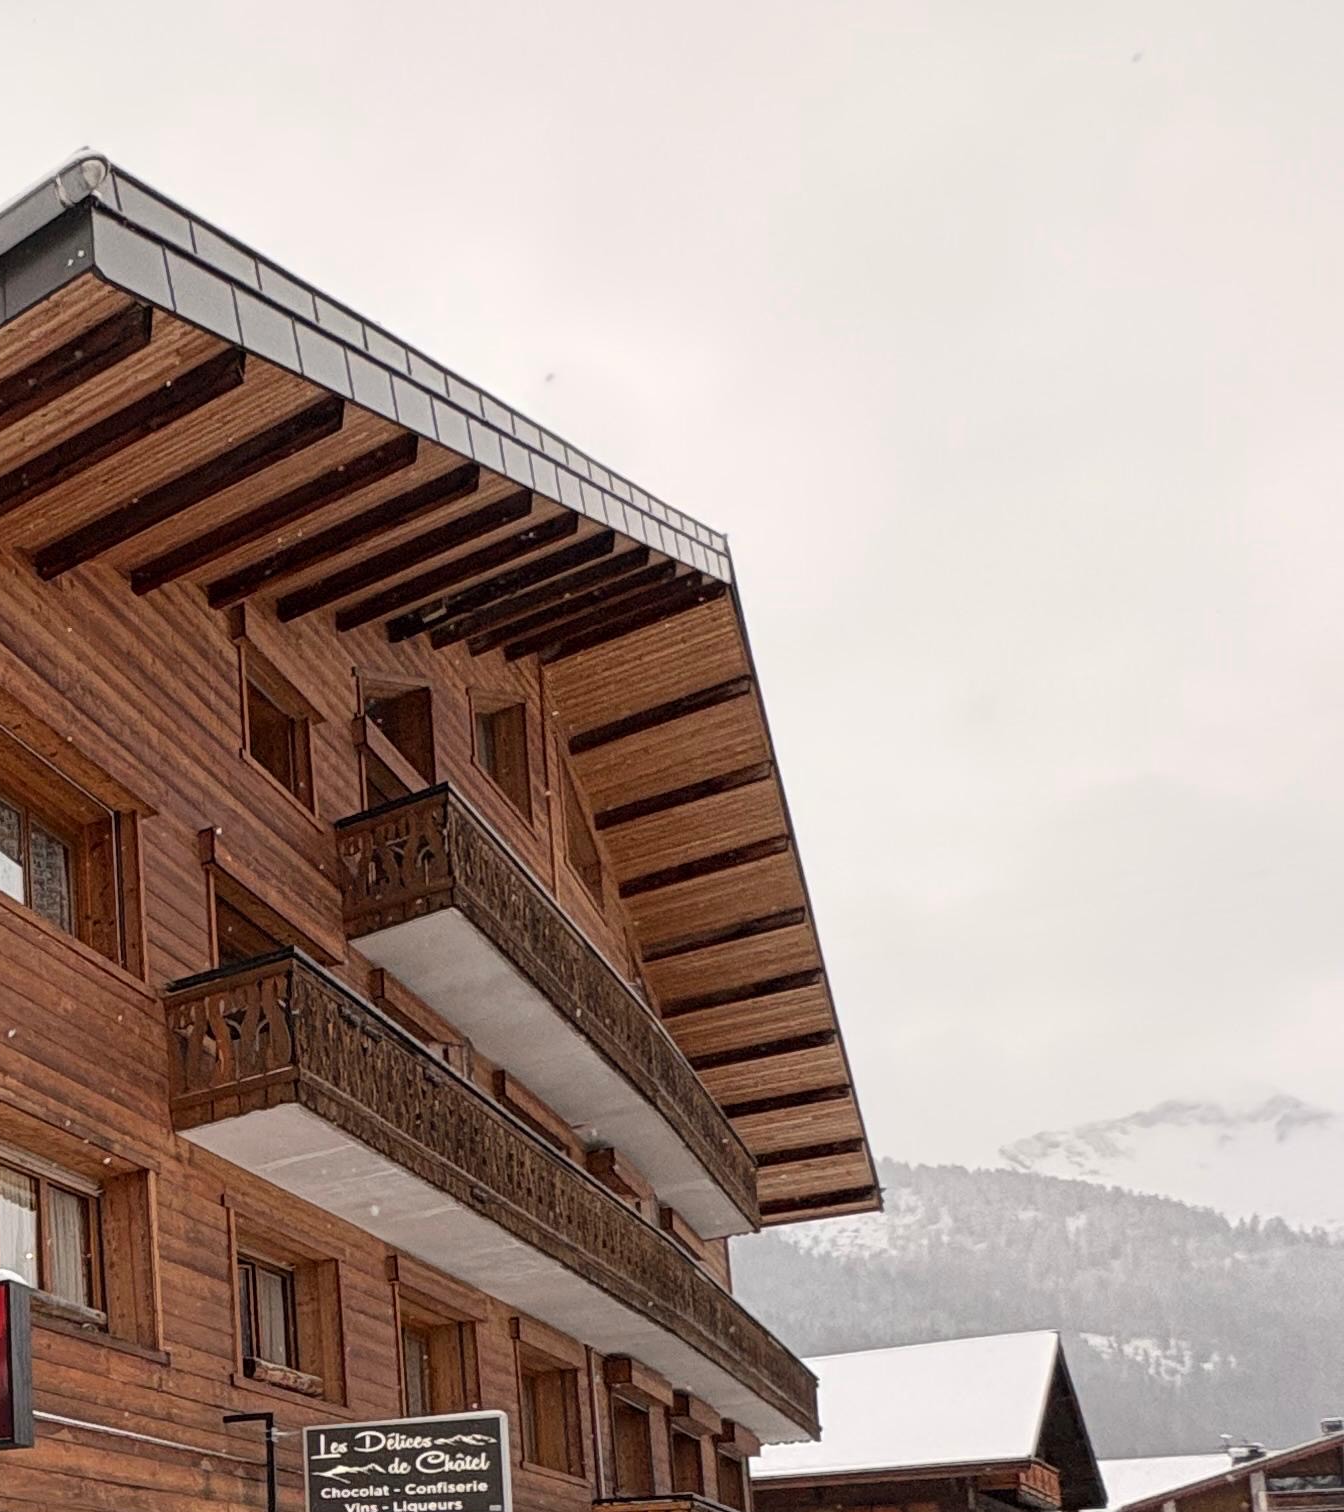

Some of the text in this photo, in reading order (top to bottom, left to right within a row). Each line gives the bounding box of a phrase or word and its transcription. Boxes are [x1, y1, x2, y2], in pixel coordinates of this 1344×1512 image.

[310, 1430, 434, 1460] Les Délices
[387, 1450, 491, 1475] de Châtel
[320, 1484, 390, 1501] Chocolat
[404, 1479, 489, 1497] Confiserie
